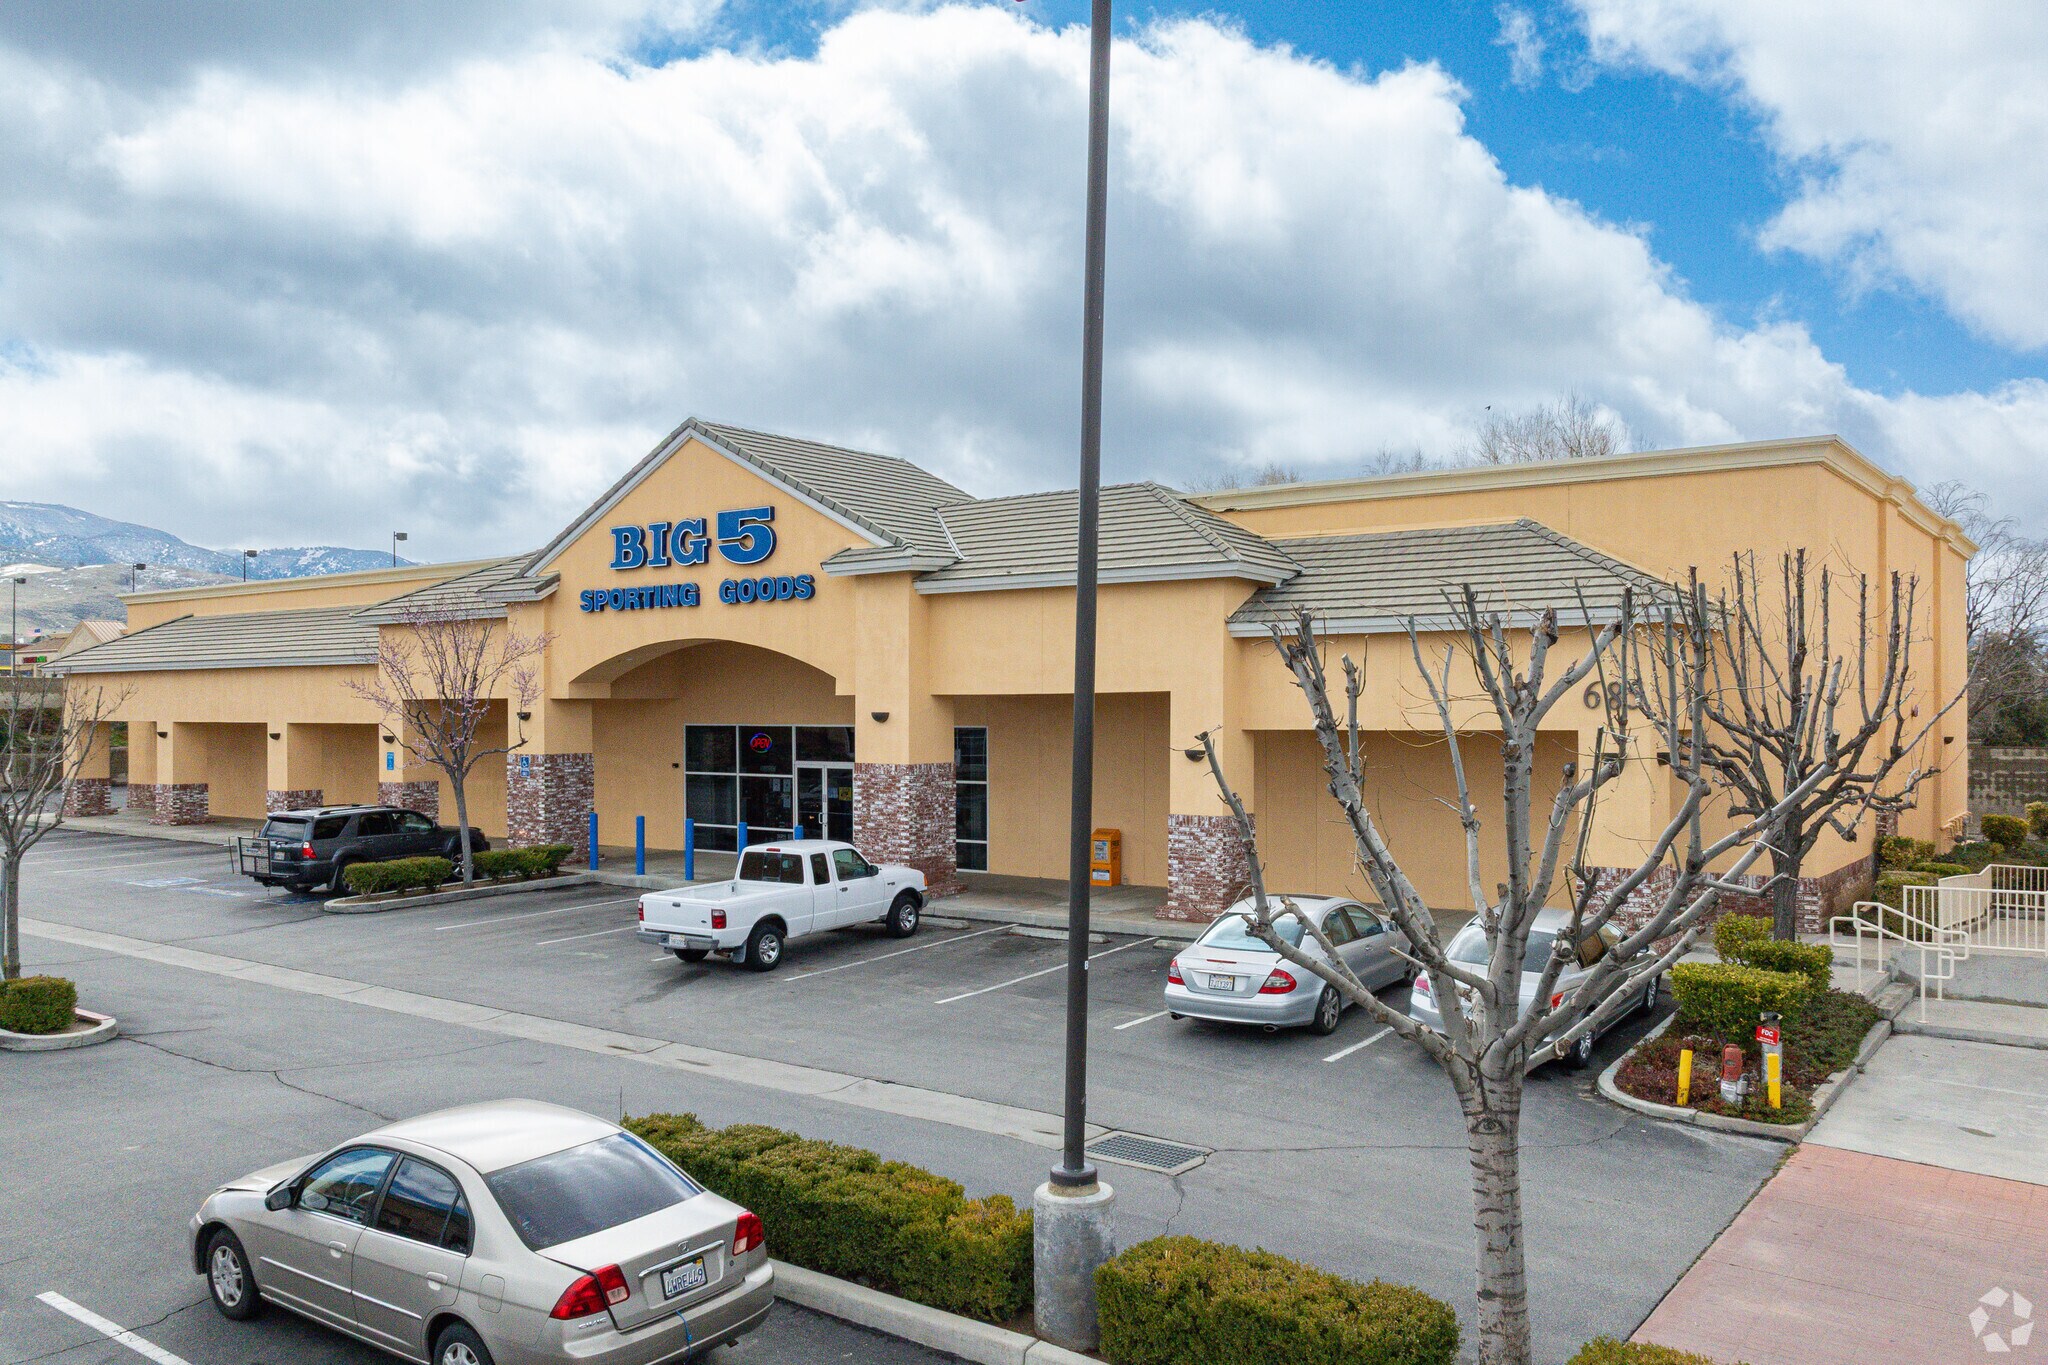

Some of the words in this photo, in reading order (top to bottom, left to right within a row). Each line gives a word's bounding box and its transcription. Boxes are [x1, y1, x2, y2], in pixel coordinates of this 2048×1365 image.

[609, 517, 712, 571] BIG
[716, 505, 777, 565] 5
[580, 582, 700, 613] SPORTING
[719, 573, 816, 604] GOODS
[751, 737, 770, 749] OPEN
[1761, 1028, 1774, 1038] FDC
[666, 1267, 704, 1294] 4WRE449
